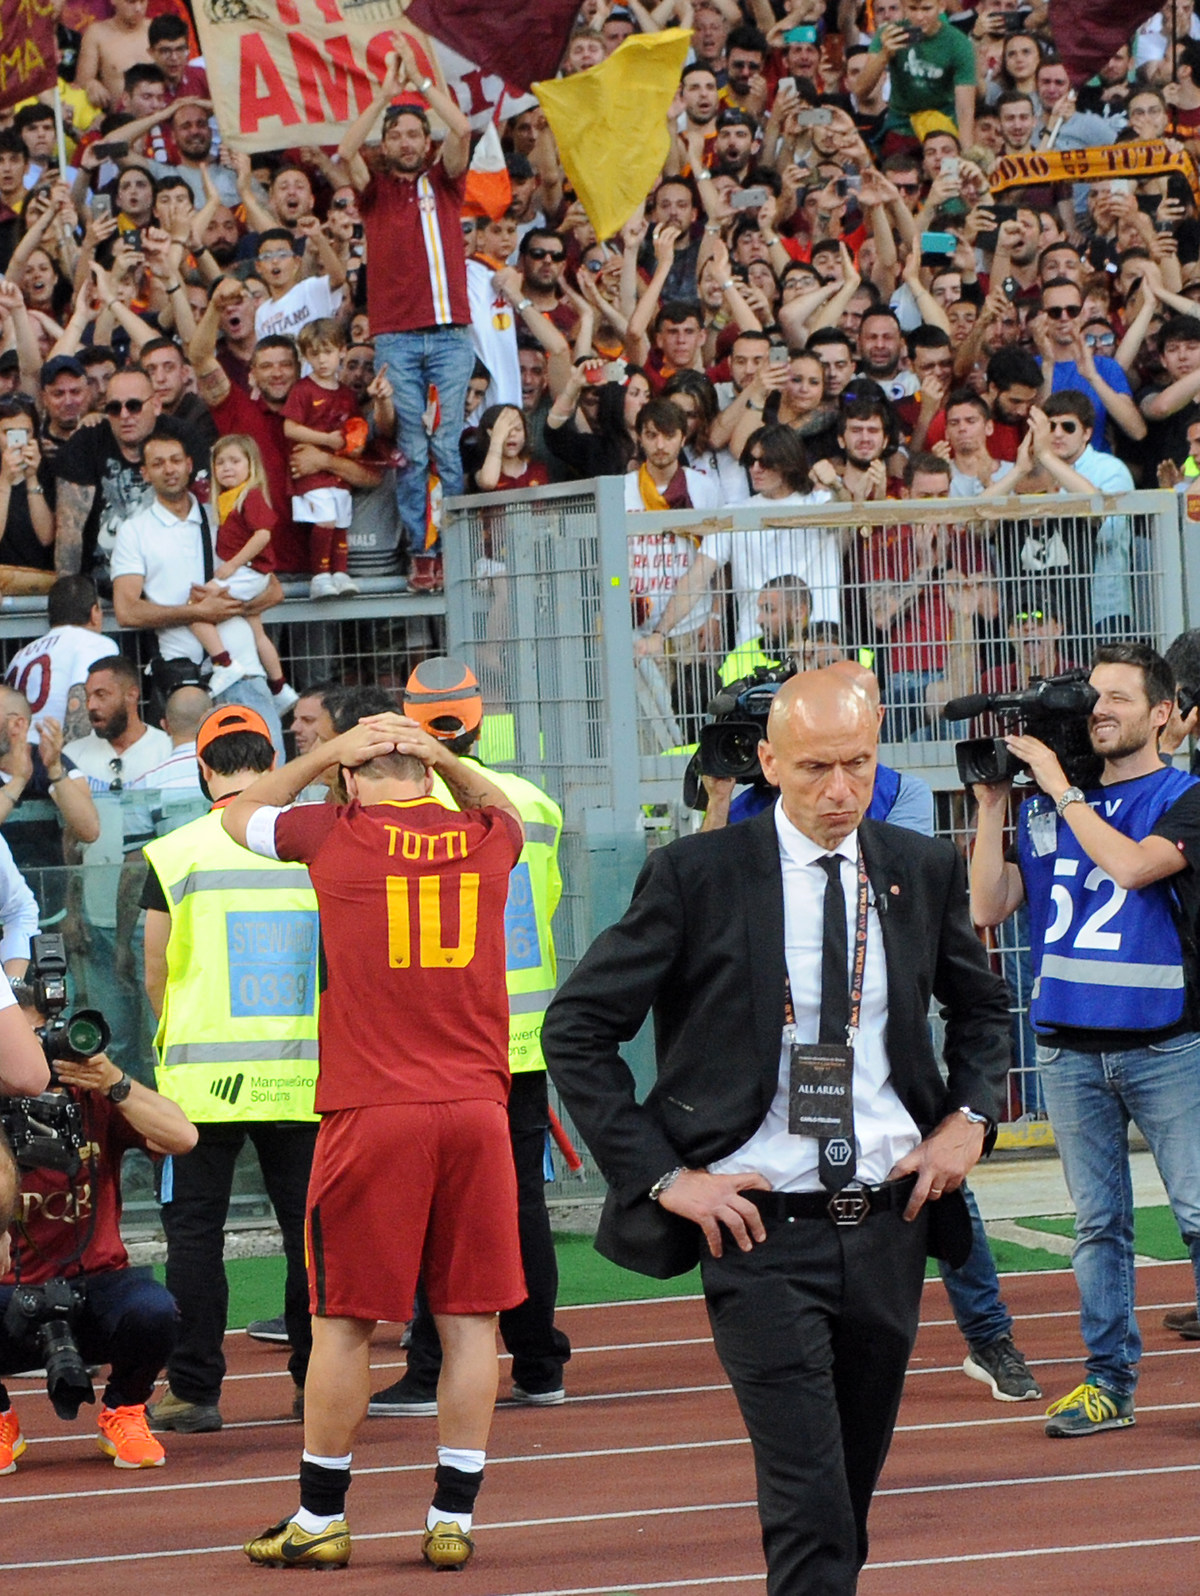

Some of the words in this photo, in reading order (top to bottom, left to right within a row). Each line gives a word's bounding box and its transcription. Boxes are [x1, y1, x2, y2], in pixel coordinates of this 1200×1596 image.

[383, 824, 468, 861] TOTTI
[1043, 857, 1128, 951] 52
[238, 972, 308, 1007] 0339
[798, 1084, 816, 1095] ALL
[816, 1085, 846, 1096] AREAS
